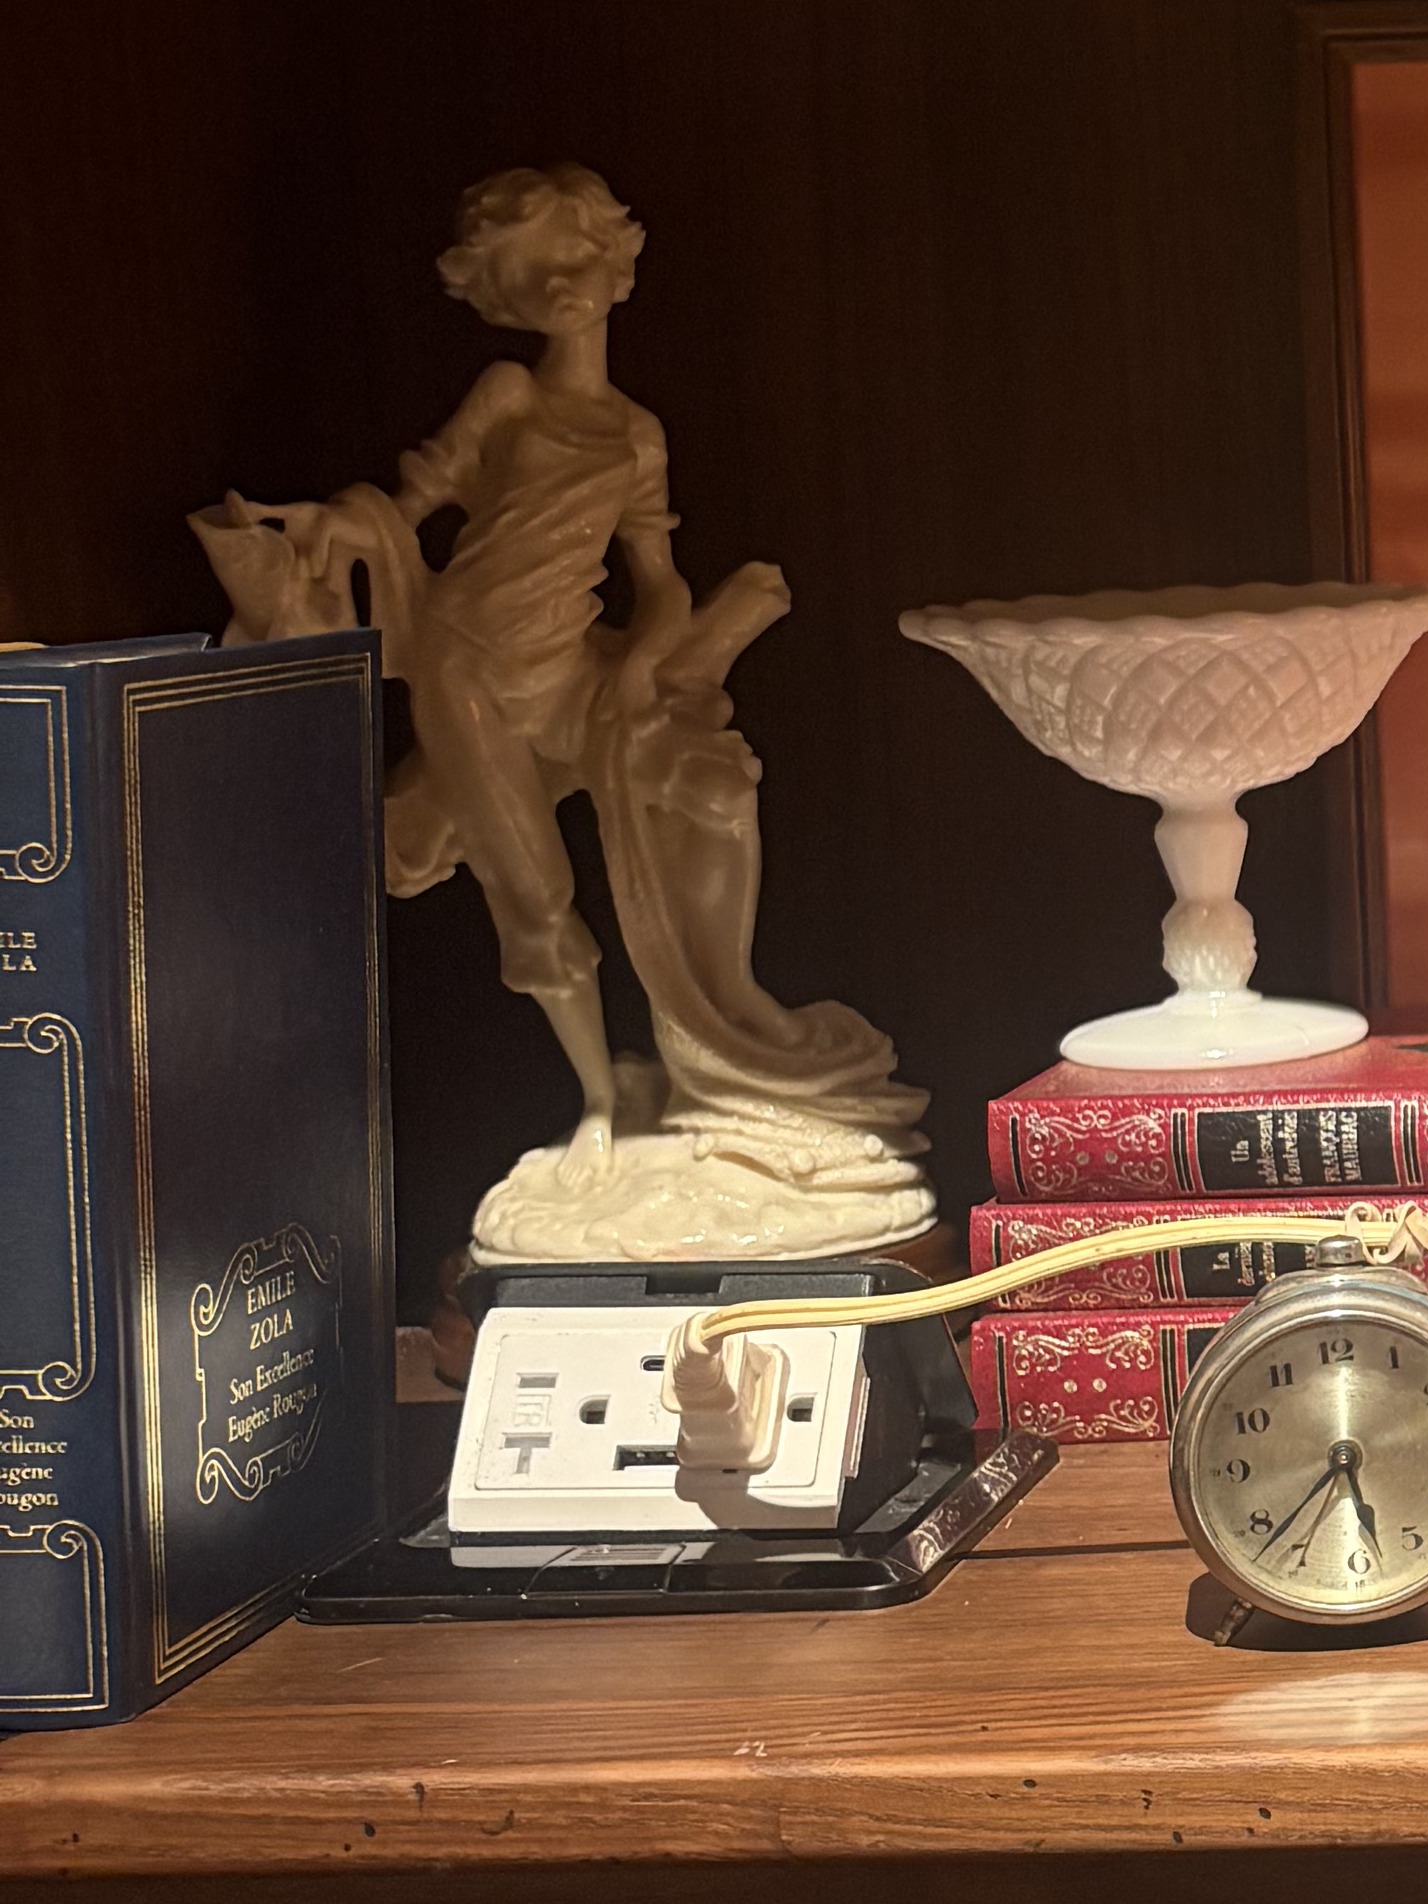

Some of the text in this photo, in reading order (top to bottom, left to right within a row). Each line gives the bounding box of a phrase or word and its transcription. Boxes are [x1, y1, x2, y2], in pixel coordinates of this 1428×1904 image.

[2, 954, 37, 971] LA
[1230, 1140, 1249, 1162] Un
[1256, 1111, 1279, 1185] adolescent
[1340, 1111, 1362, 1181] MAURIAC
[1212, 1251, 1230, 1270] La
[247, 1270, 296, 1315] EMILE
[249, 1308, 294, 1351] ZOLA
[1318, 1338, 1354, 1365] 12
[1388, 1345, 1399, 1370] 1
[1268, 1362, 1294, 1388] 11
[229, 1378, 254, 1405] Son
[228, 1405, 271, 1443] Eugène
[1233, 1407, 1270, 1435] 10
[1226, 1458, 1251, 1484] 9
[1249, 1508, 1274, 1535] 8
[1401, 1525, 1424, 1551] 5
[1347, 1548, 1371, 1574] 6
